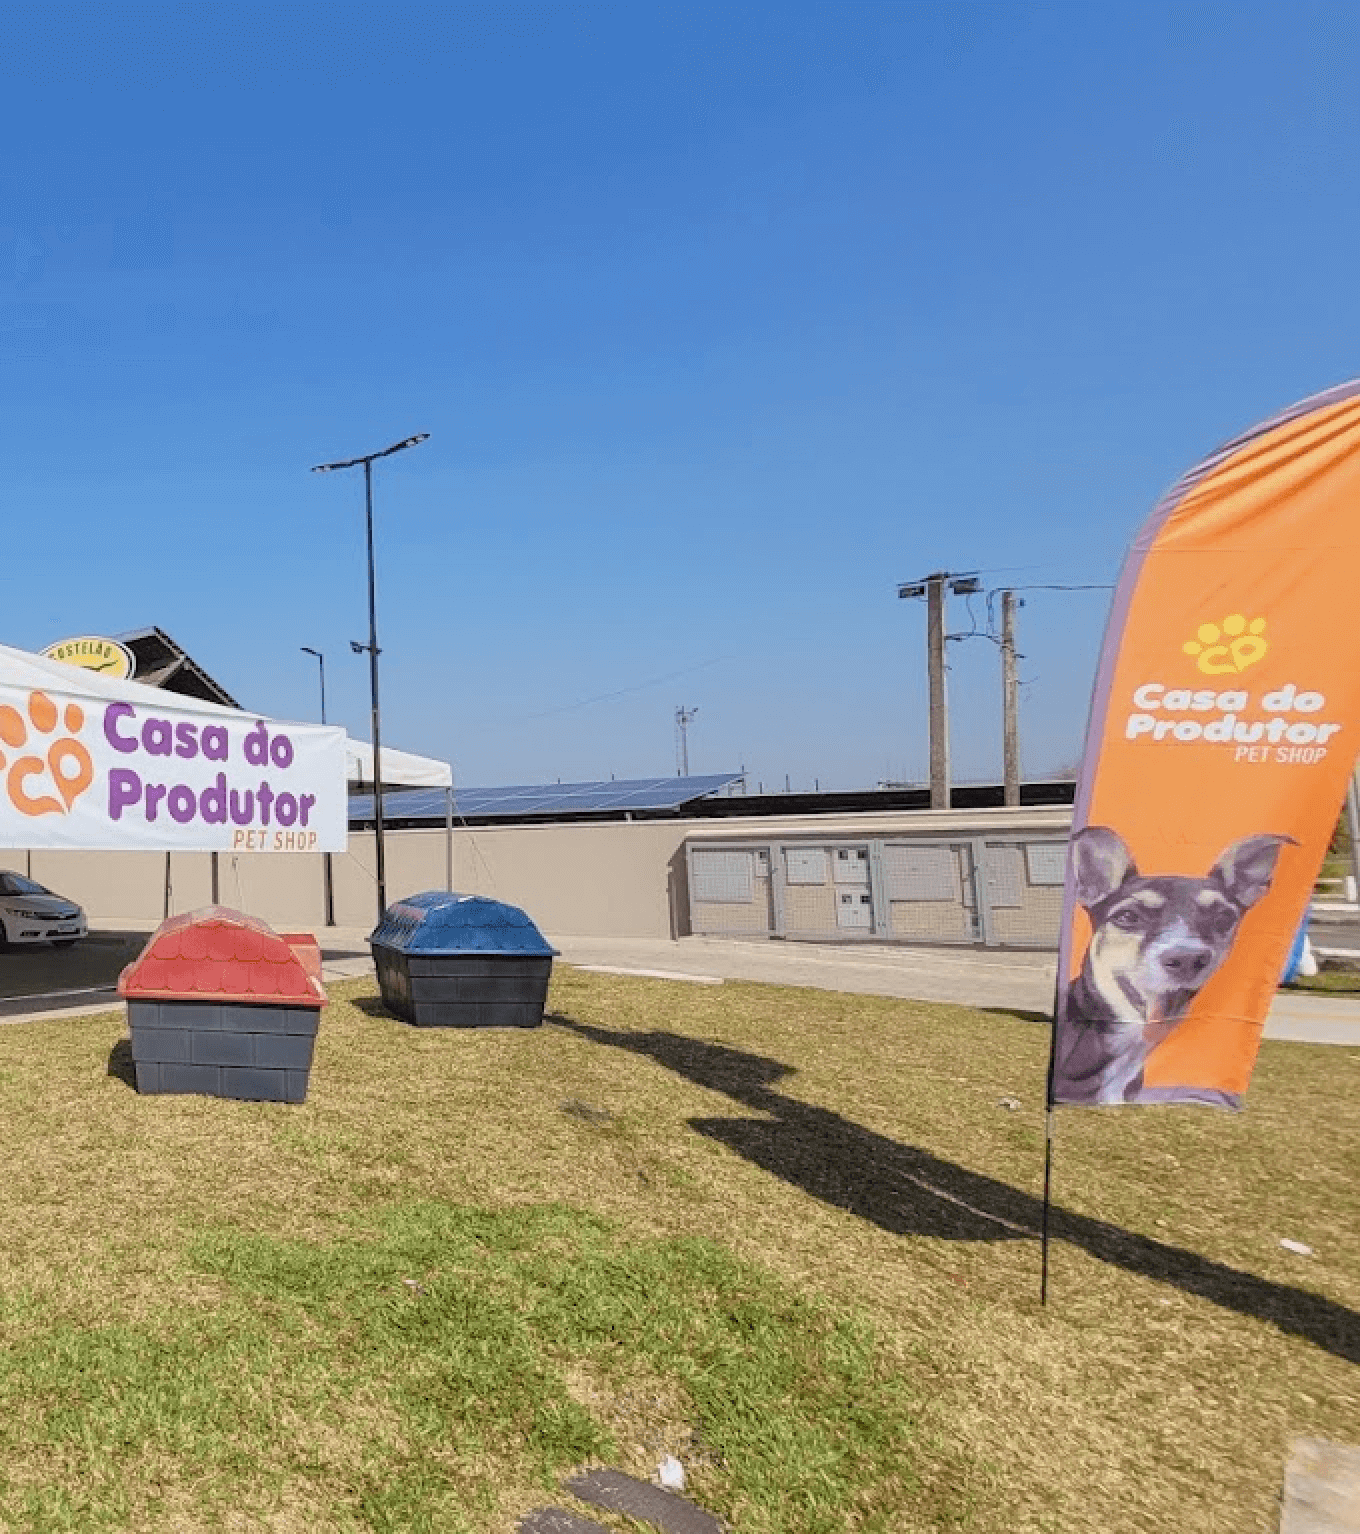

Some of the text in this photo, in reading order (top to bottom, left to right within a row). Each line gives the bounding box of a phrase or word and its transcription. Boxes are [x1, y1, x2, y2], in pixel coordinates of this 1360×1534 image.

[1133, 683, 1325, 713] Casa do
[104, 701, 293, 768] Casa do
[1125, 713, 1342, 744] Produtor
[1234, 746, 1327, 764] PET SHOP
[108, 768, 316, 827] Produtor
[234, 829, 317, 850] PET SHOP
